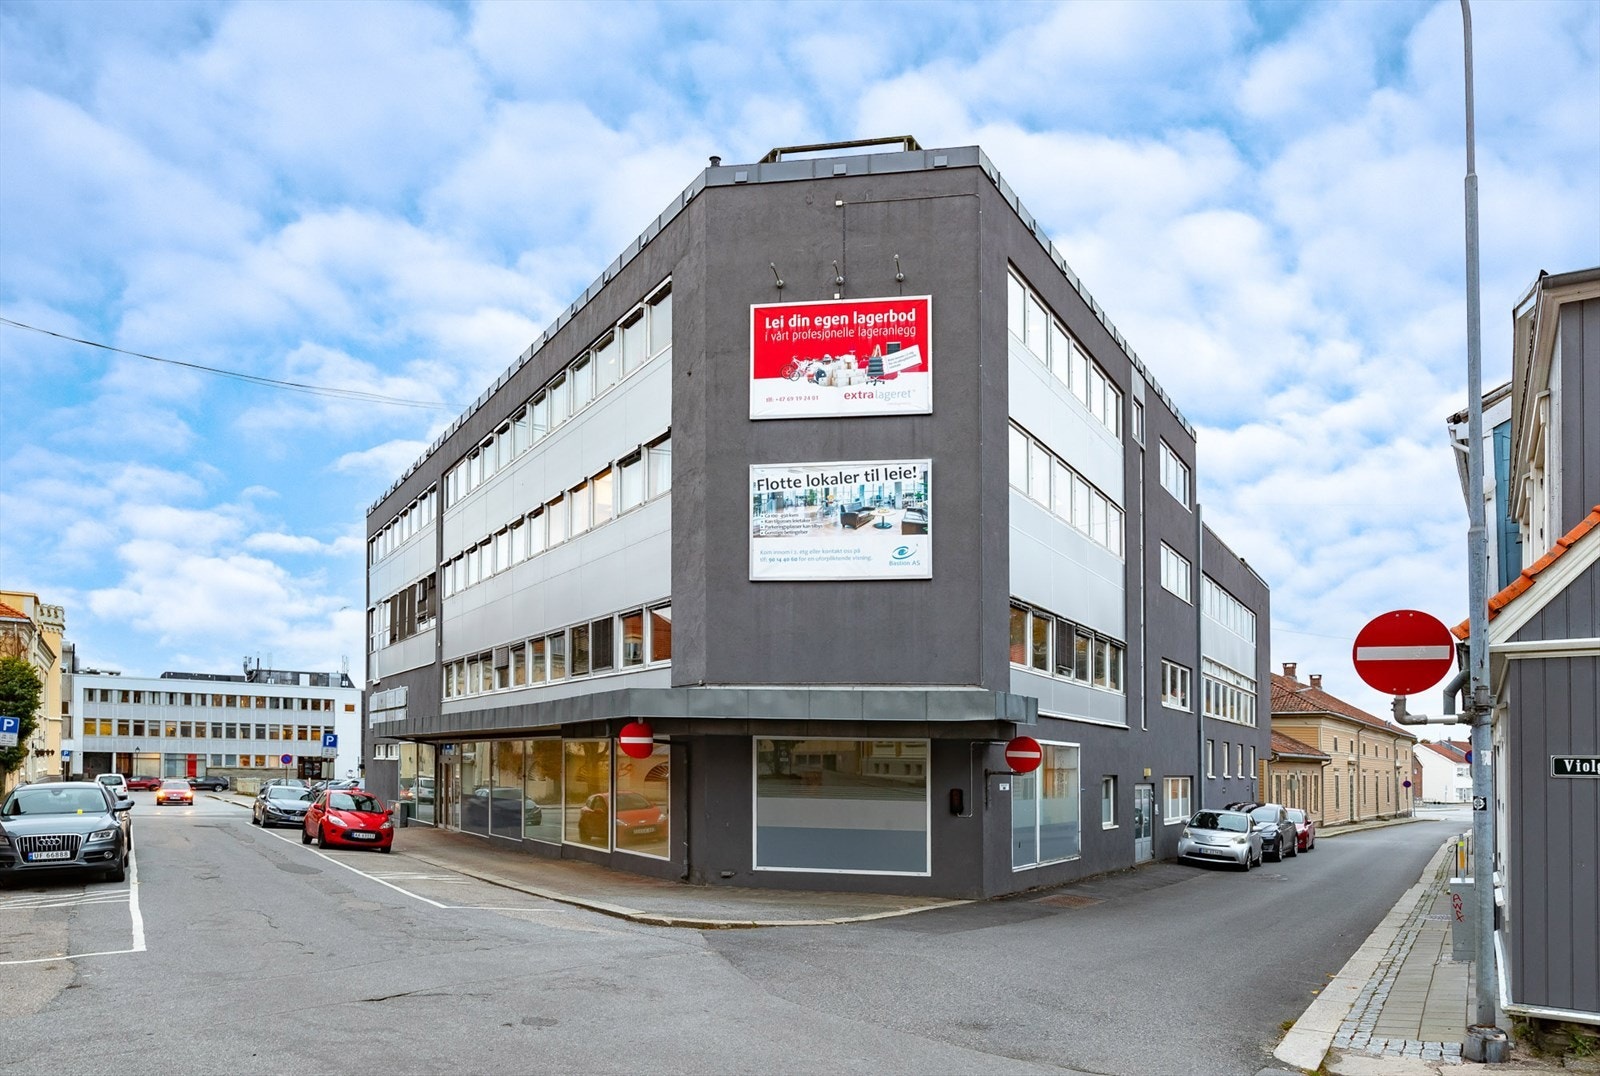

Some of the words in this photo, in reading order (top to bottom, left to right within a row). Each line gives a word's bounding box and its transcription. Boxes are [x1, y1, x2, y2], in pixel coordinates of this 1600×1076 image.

[765, 315, 784, 329] Lei
[788, 314, 810, 328] din
[814, 314, 849, 329] egen
[853, 307, 916, 327] lagerbod
[765, 332, 768, 342] i
[771, 331, 789, 341] vårt
[792, 327, 855, 342] profesjonelle
[858, 324, 916, 339] lageranlegg
[756, 477, 802, 491] Flotte
[806, 471, 860, 488] lokaler
[864, 469, 879, 483] til
[884, 466, 917, 481] leie!
[3, 719, 15, 731] P
[326, 736, 334, 746] P
